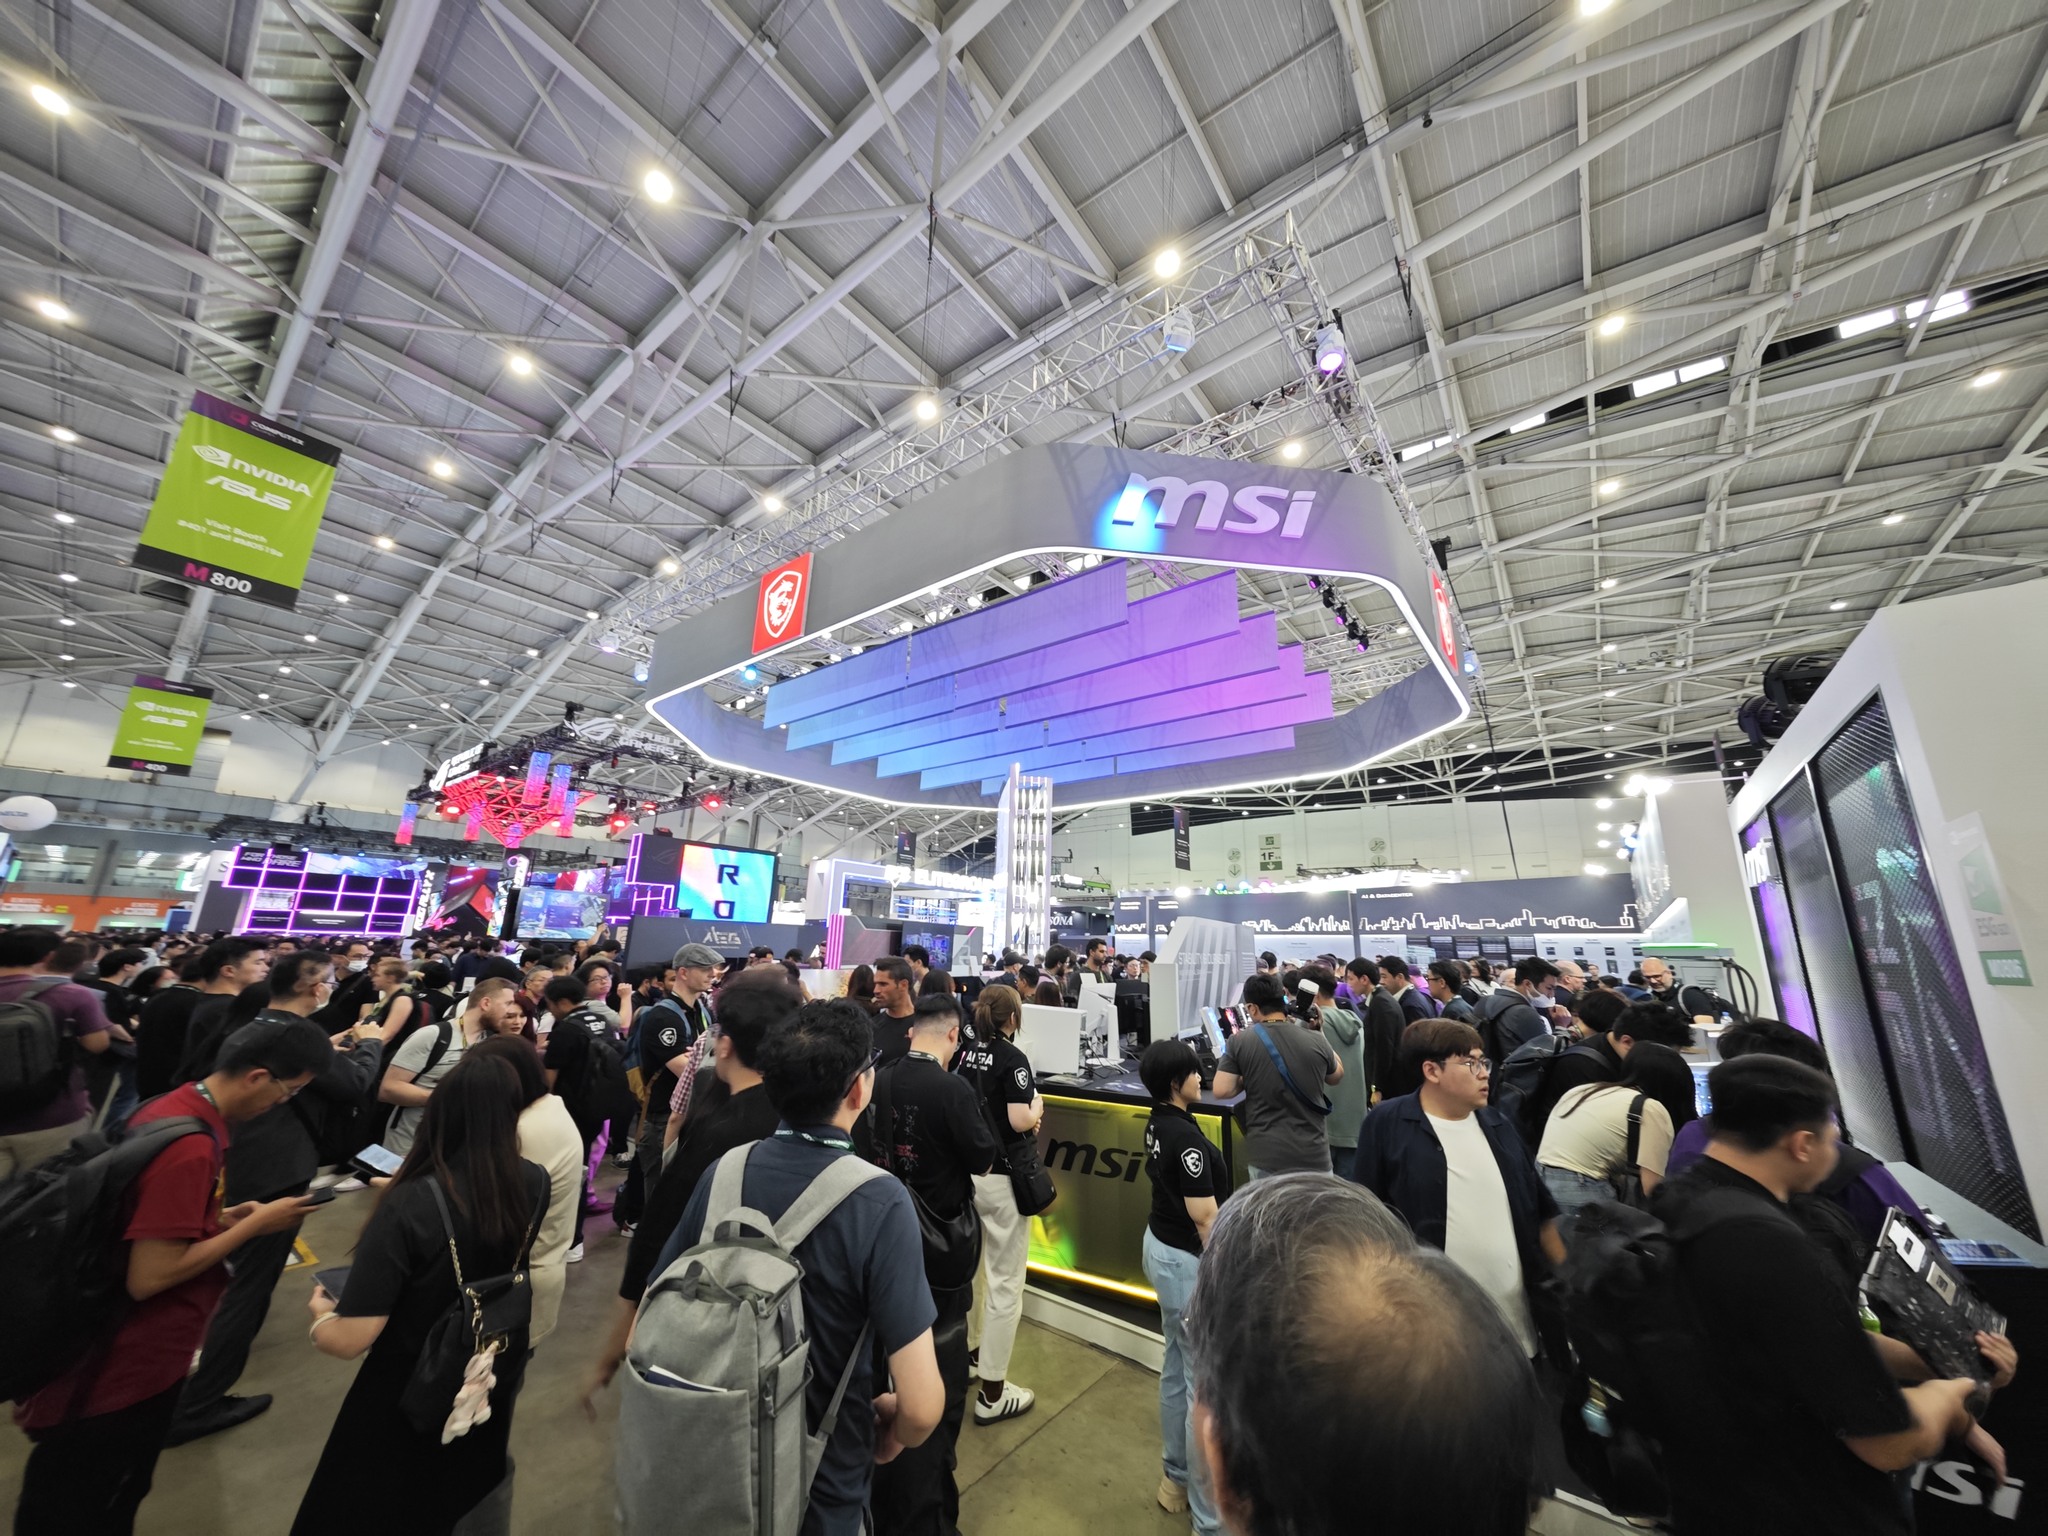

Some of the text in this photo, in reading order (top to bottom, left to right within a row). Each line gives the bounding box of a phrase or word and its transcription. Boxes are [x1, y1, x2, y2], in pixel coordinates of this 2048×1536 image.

[250, 420, 305, 446] COMPUTEX
[206, 475, 291, 511] ASUS
[1111, 471, 1317, 539] msi
[184, 562, 252, 594] M 800
[1044, 1138, 1144, 1183] msi
